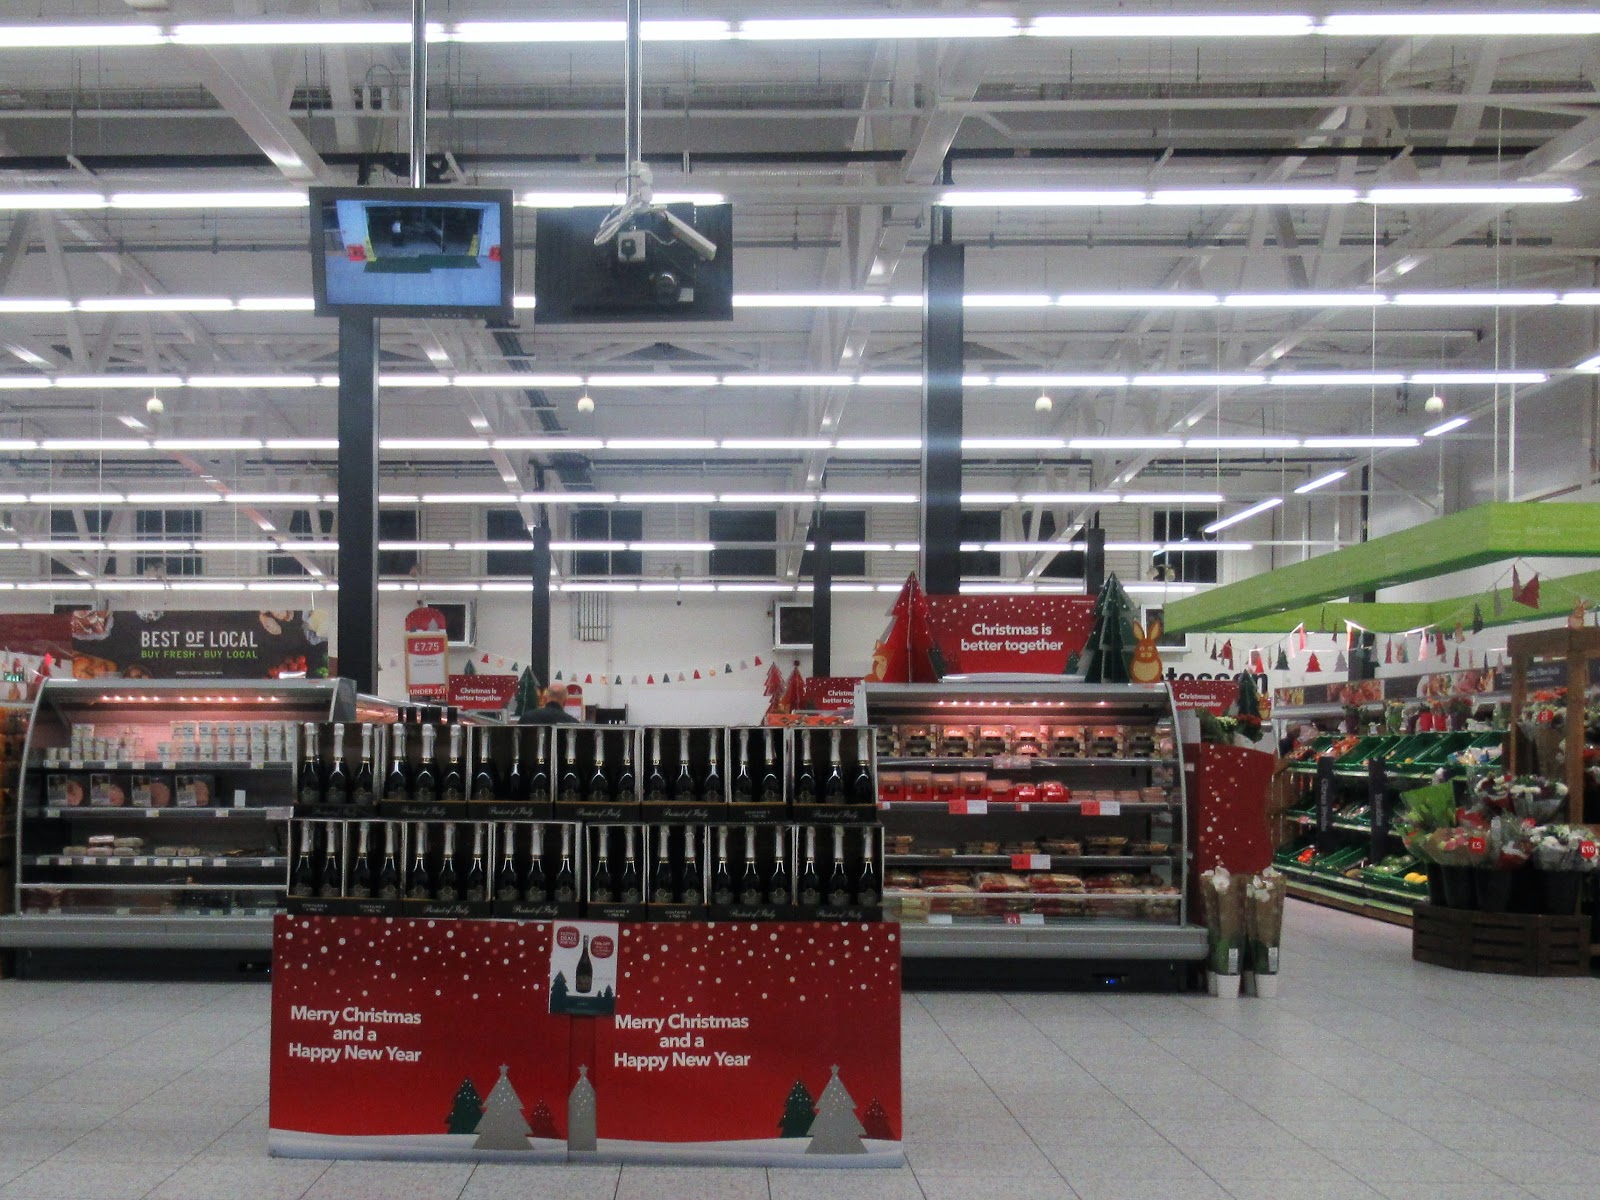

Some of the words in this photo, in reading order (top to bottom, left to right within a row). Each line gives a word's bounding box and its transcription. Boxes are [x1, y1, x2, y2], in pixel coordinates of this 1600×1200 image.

[971, 622, 1039, 636] Christmas
[1041, 622, 1052, 636] is
[141, 631, 180, 648] BEST
[185, 631, 205, 643] OF
[210, 631, 259, 648] LOCAL
[414, 642, 440, 652] £7.75
[960, 638, 1003, 652] better
[1005, 638, 1064, 654] together
[141, 650, 160, 659] BUY
[163, 650, 196, 659] FRESH
[203, 650, 223, 659] BUY
[226, 650, 259, 659] LOCAL
[460, 687, 491, 695] Christmas
[1179, 692, 1211, 700] Christmas
[475, 695, 502, 703] together
[1471, 841, 1482, 849] £5
[1581, 845, 1595, 853] £10
[290, 1005, 340, 1026] Merry
[342, 1006, 422, 1025] Christmas
[615, 1014, 665, 1034] Merry
[668, 1013, 750, 1030] Christmas
[333, 1025, 364, 1041] and
[367, 1030, 377, 1041] a
[660, 1032, 691, 1048] and
[694, 1036, 705, 1048] a
[289, 1042, 342, 1064] Happy
[344, 1044, 384, 1061] New
[386, 1045, 422, 1062] Year
[614, 1052, 669, 1072] Happy
[672, 1052, 712, 1067] New
[714, 1051, 751, 1067] Year
